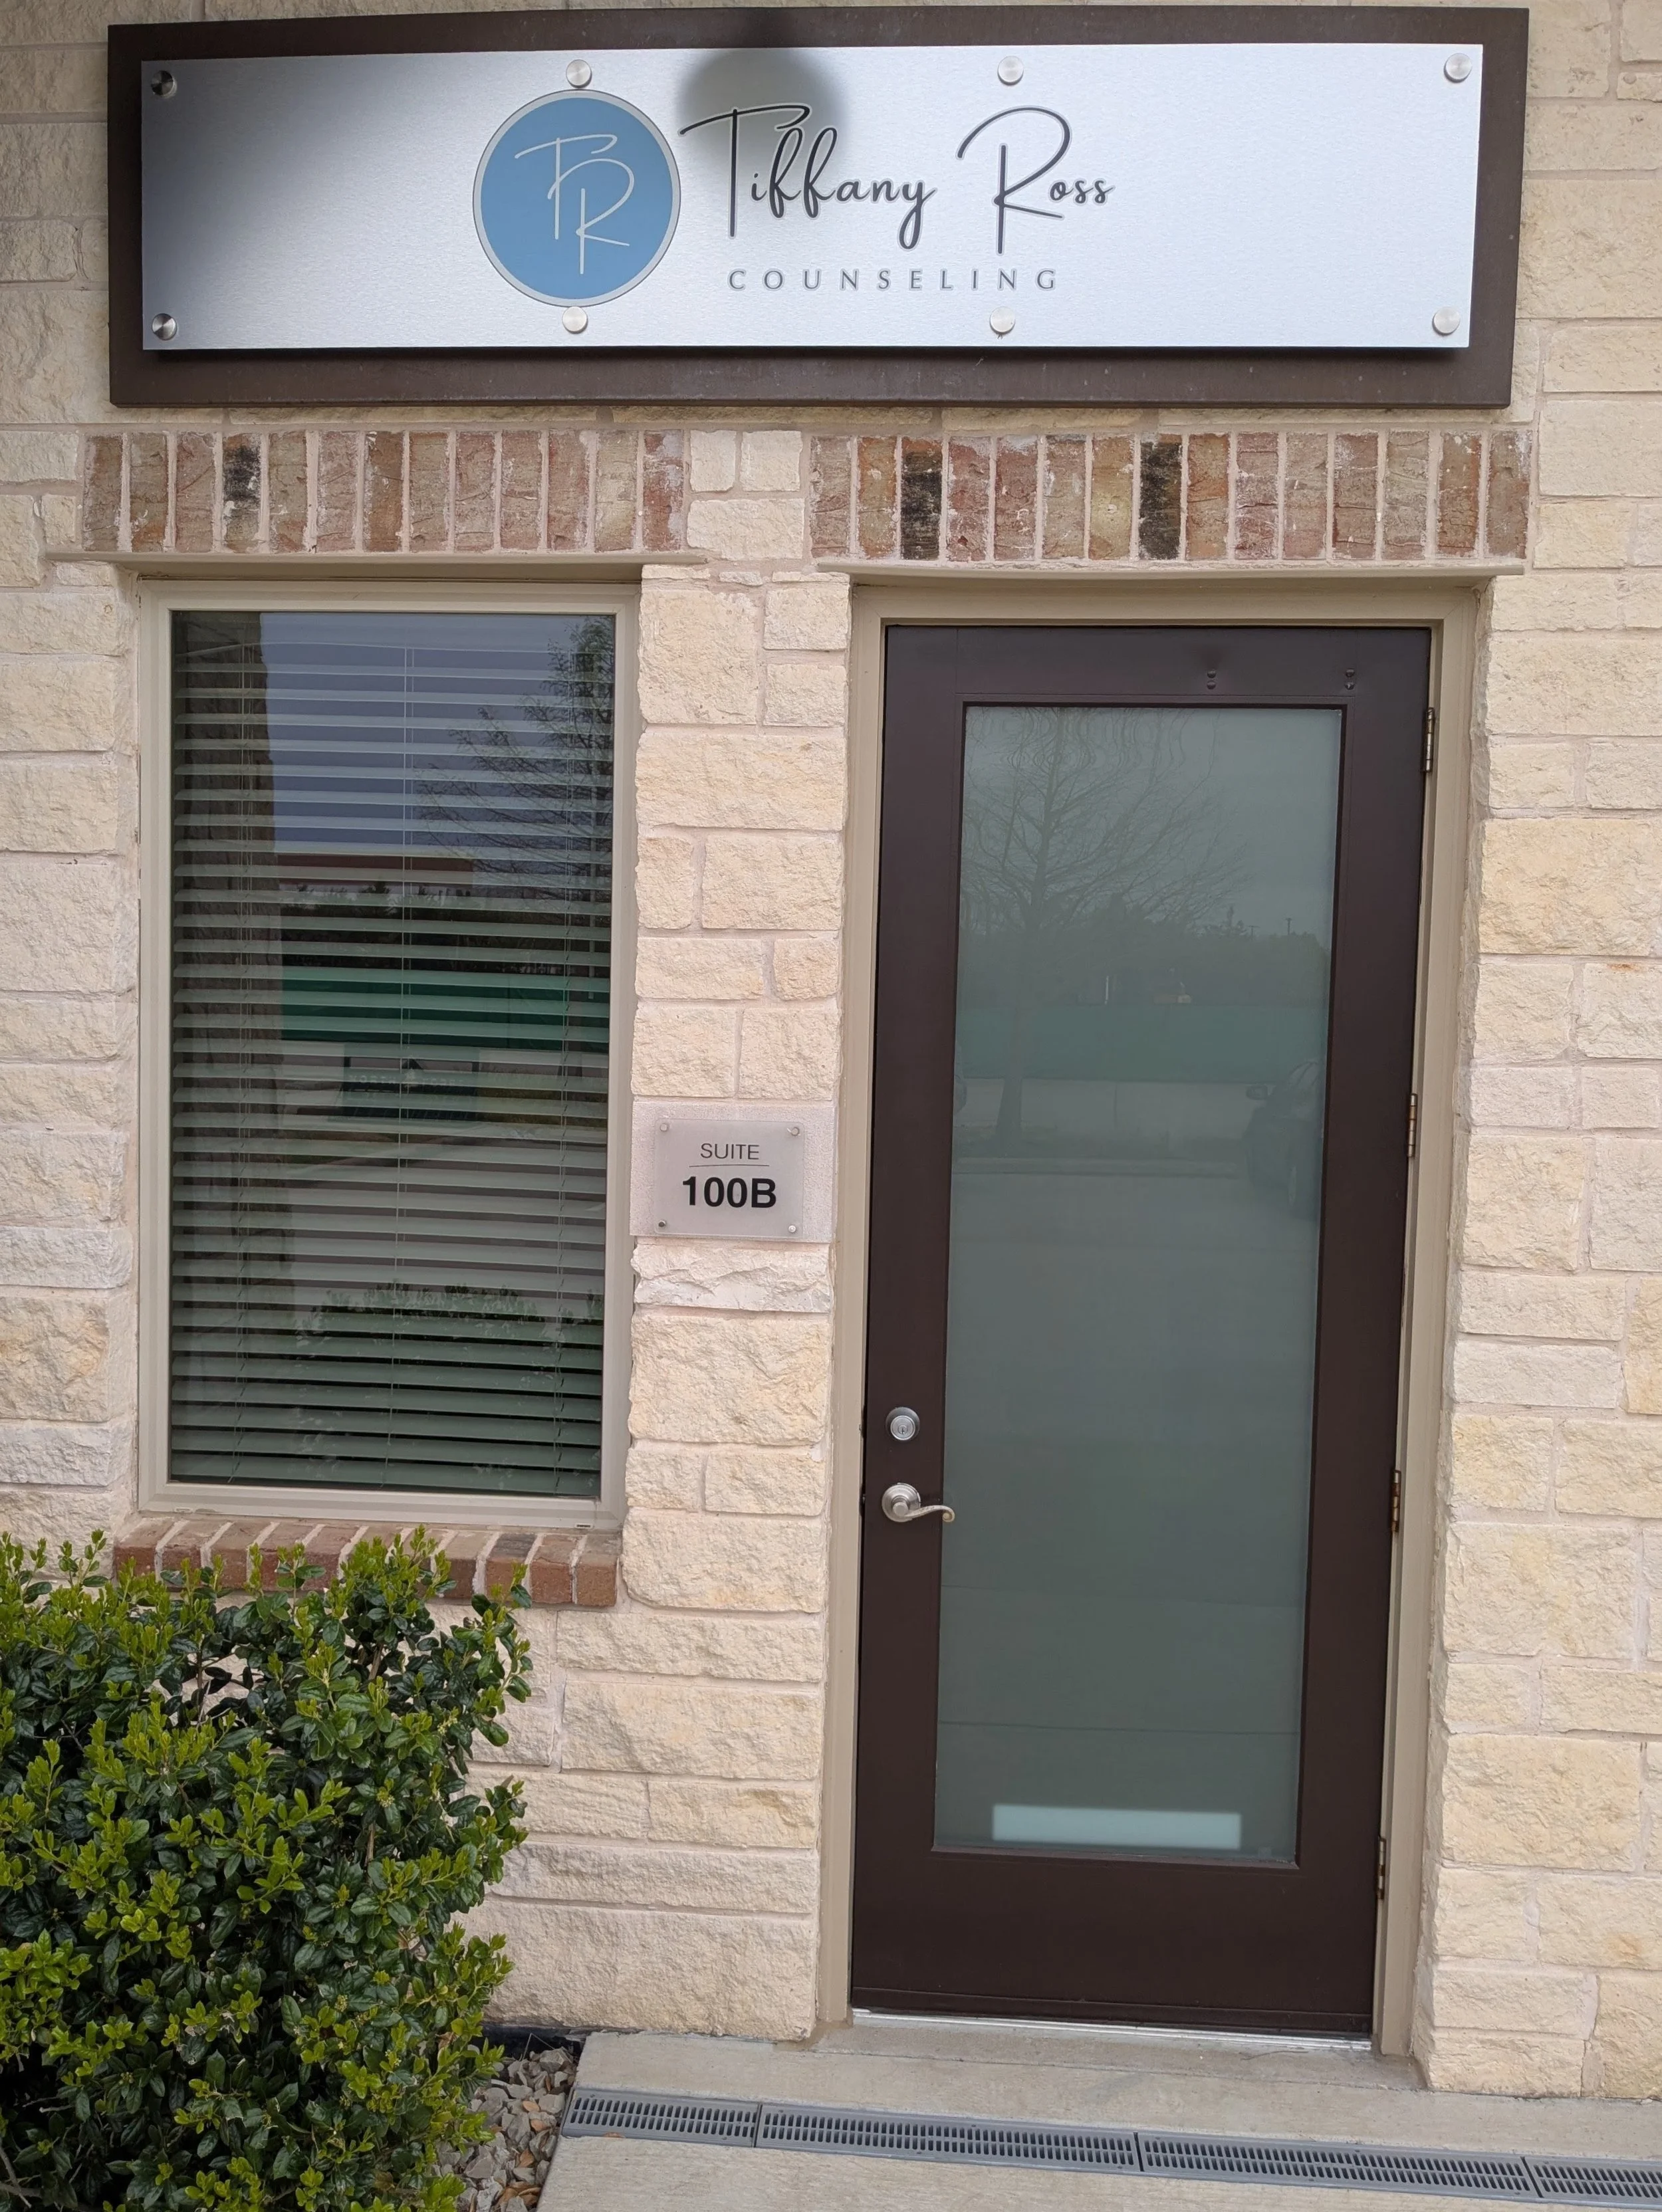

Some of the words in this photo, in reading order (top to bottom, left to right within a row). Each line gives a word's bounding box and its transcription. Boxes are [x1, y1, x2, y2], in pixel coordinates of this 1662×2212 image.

[679, 104, 935, 250] Tiffany
[957, 105, 1115, 254] Ross
[727, 269, 1058, 291] COUNSELING
[700, 1143, 760, 1160] SUITE
[682, 1176, 776, 1208] 100B
